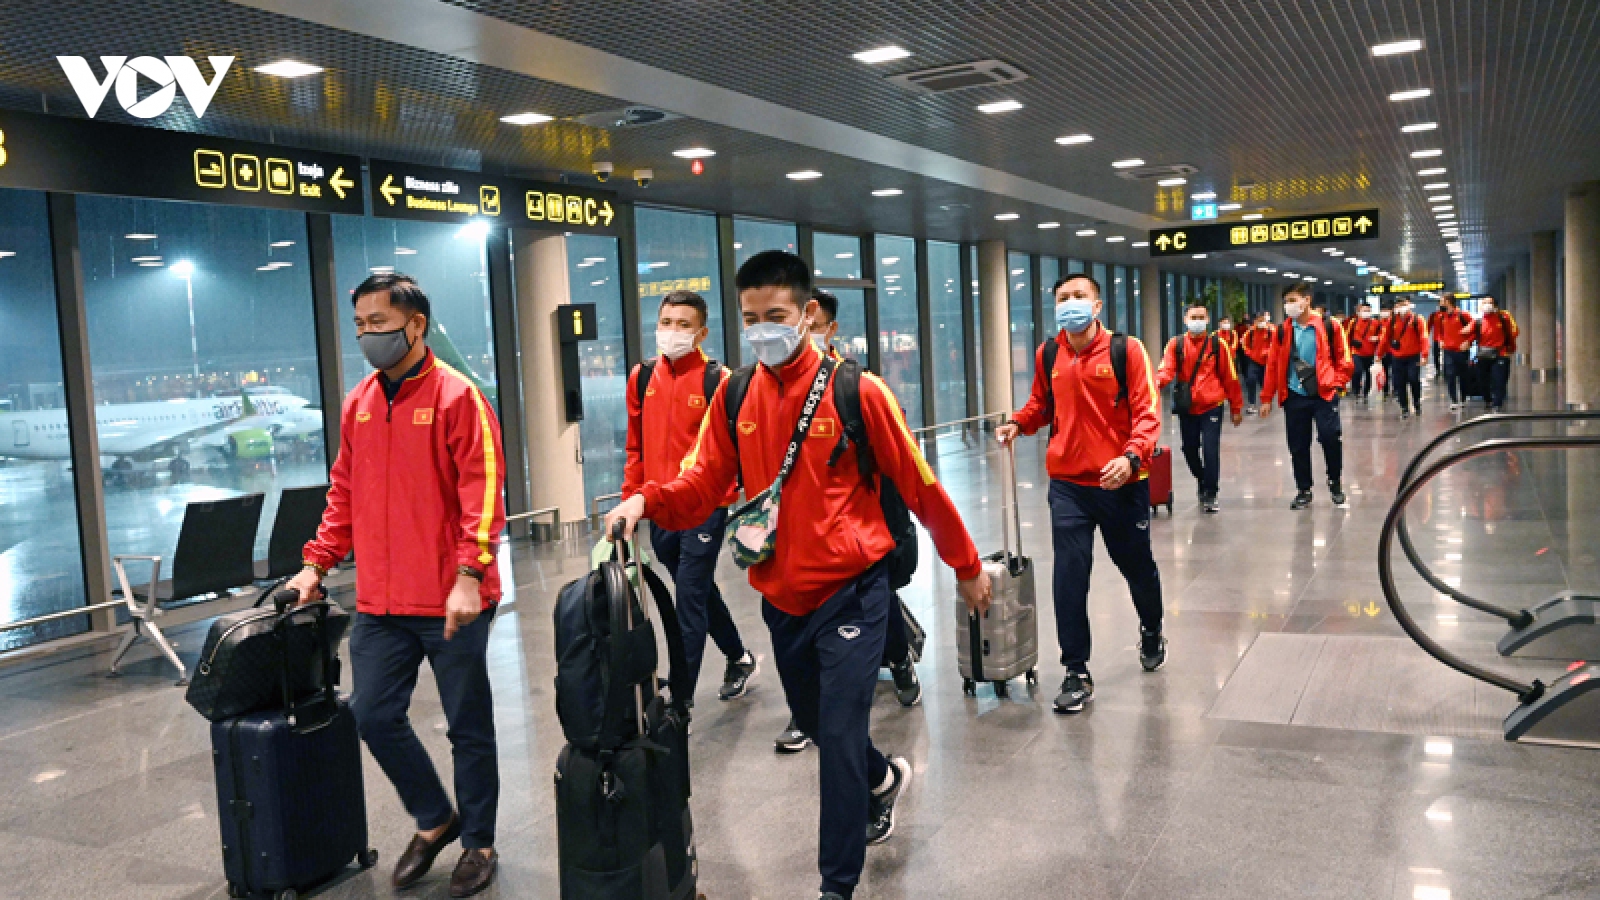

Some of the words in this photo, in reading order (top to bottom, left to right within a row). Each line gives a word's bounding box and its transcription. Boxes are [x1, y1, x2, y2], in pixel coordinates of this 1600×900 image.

[299, 182, 323, 198] Exit
[406, 194, 447, 211] Business
[584, 197, 599, 227] C
[1173, 231, 1187, 251] C
